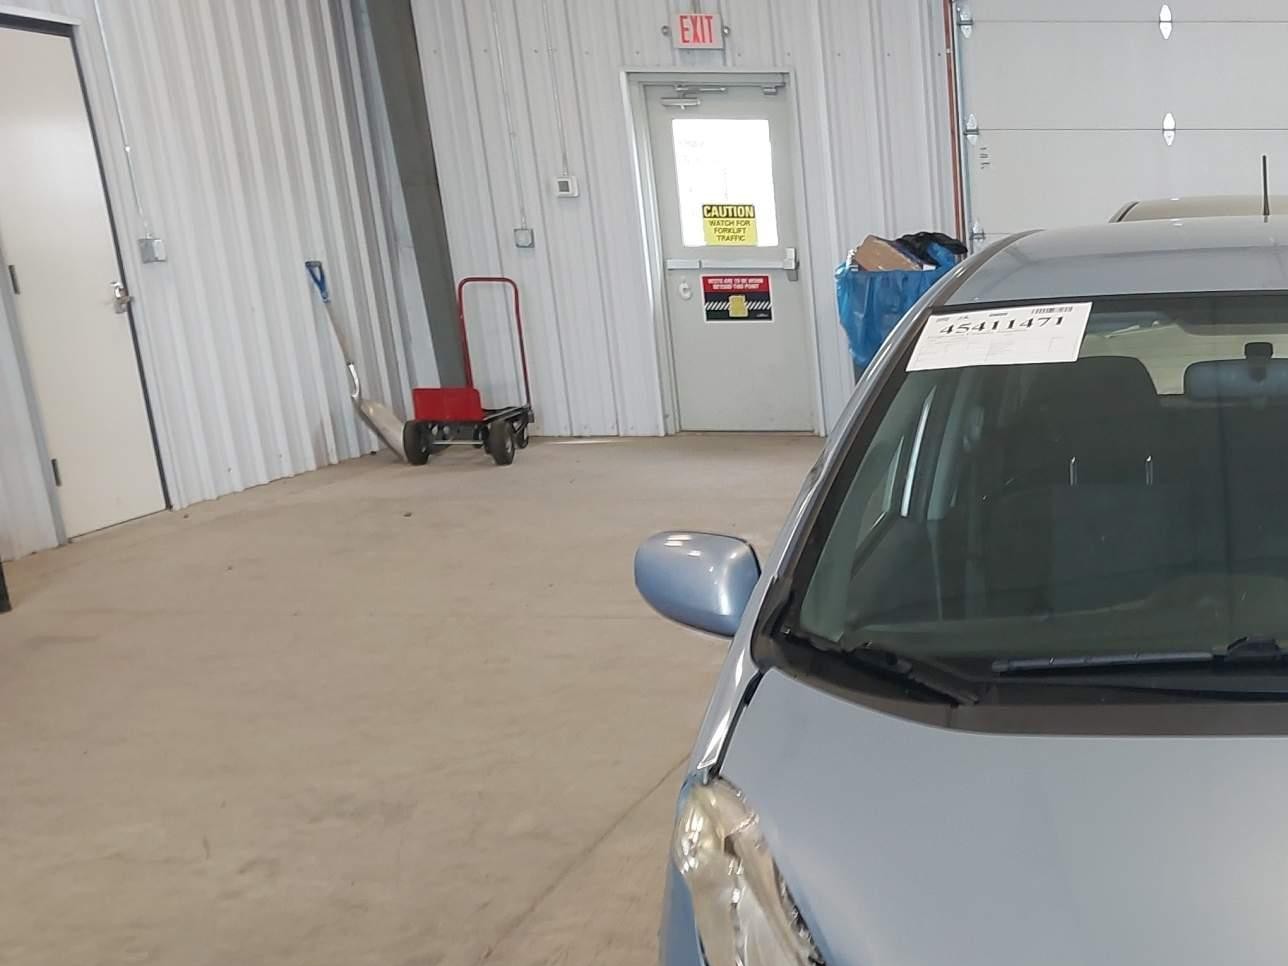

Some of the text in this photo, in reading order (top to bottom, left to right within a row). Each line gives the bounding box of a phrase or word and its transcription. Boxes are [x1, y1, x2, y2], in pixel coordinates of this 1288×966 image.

[680, 15, 713, 43] EXIT
[703, 205, 754, 218] CAUTION
[940, 316, 1064, 335] 45411471
